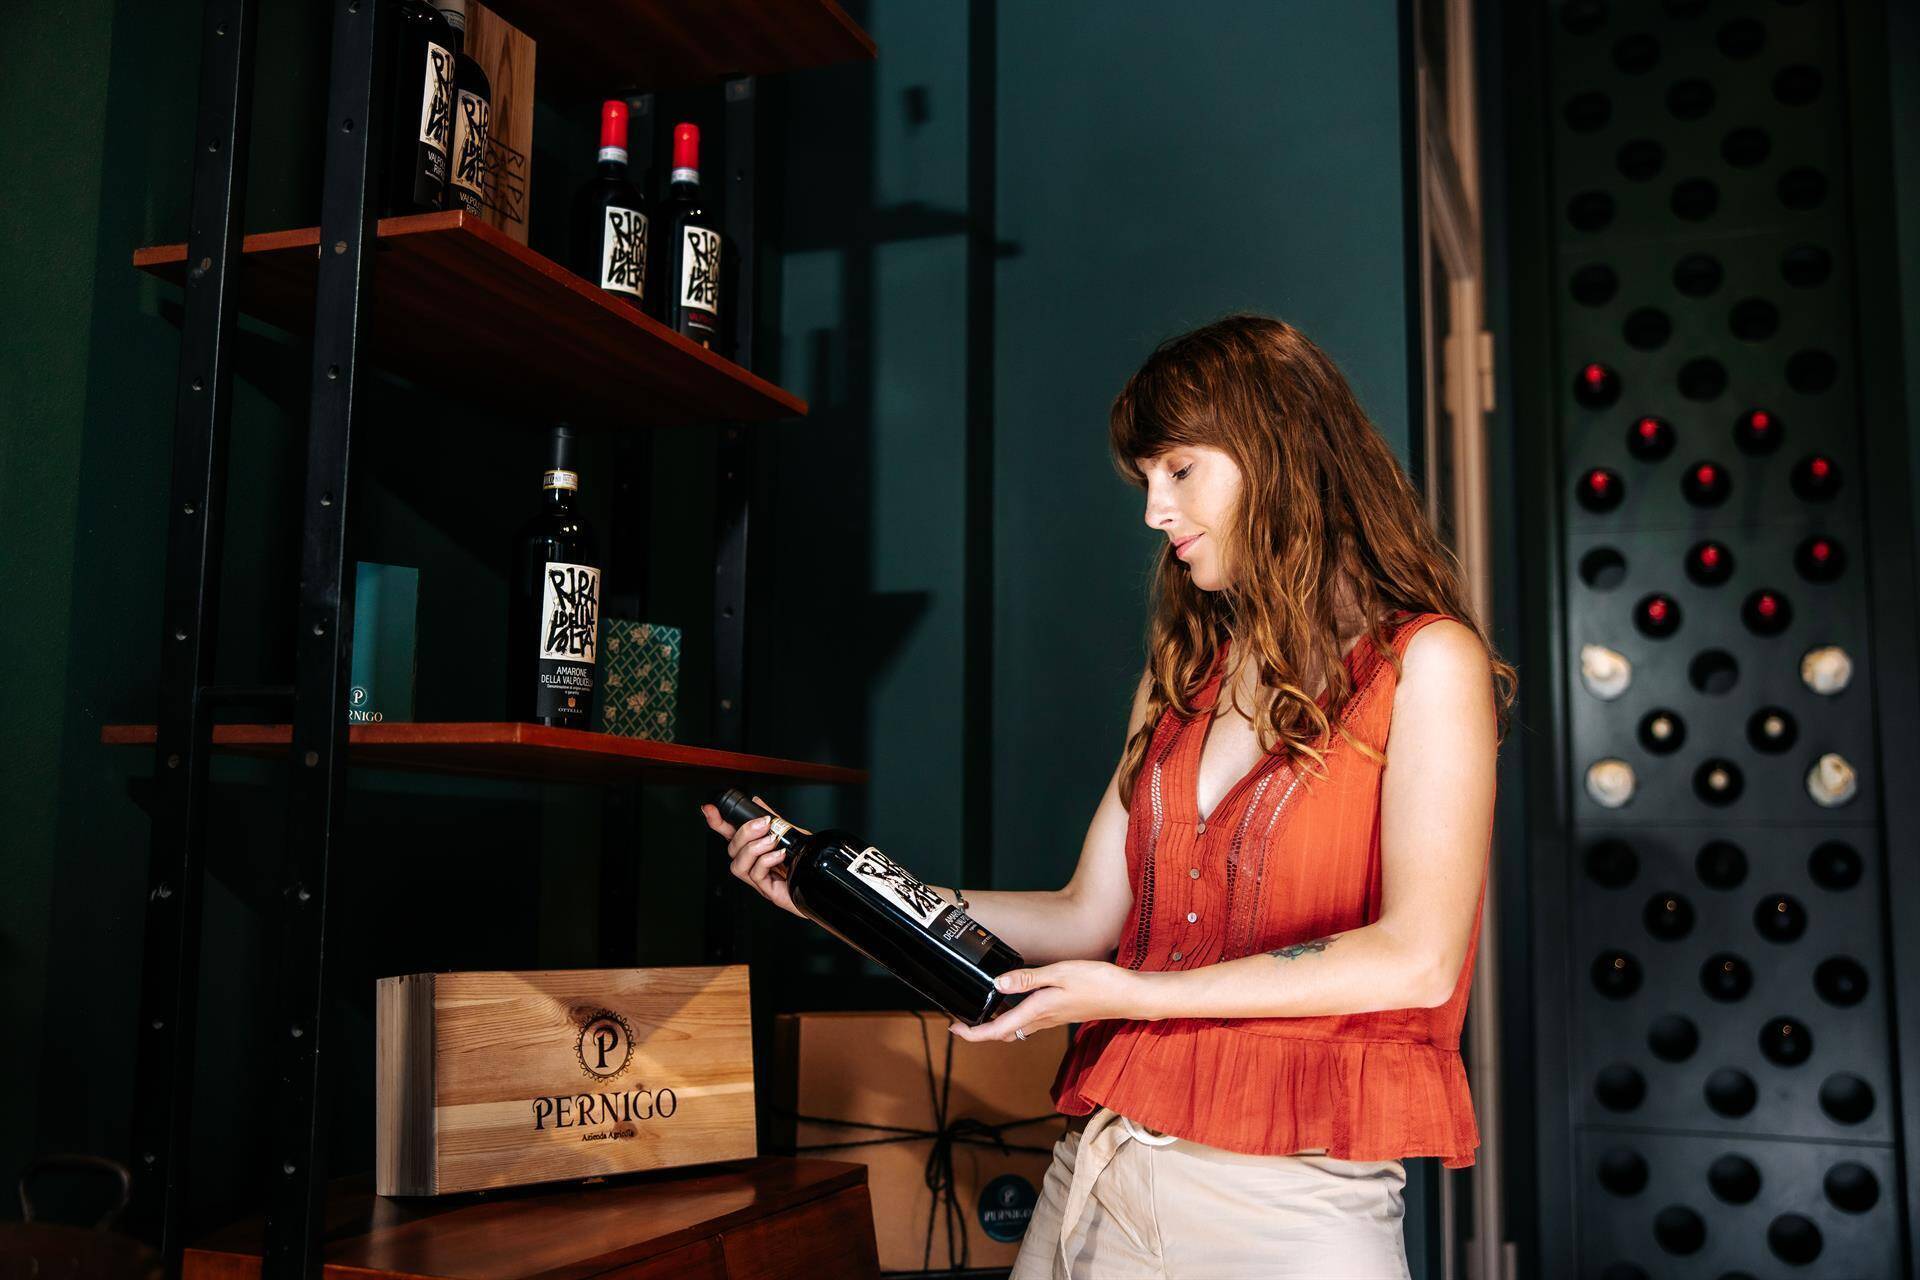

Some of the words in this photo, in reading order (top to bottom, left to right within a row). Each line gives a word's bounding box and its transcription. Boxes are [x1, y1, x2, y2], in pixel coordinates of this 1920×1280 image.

[541, 674, 561, 684] DELLA
[556, 666, 588, 678] AMARONE
[353, 689, 364, 704] P
[593, 1024, 619, 1069] P
[532, 1088, 677, 1131] PERNIGO
[581, 1131, 607, 1142] Azienda
[608, 1128, 635, 1140] Agricola
